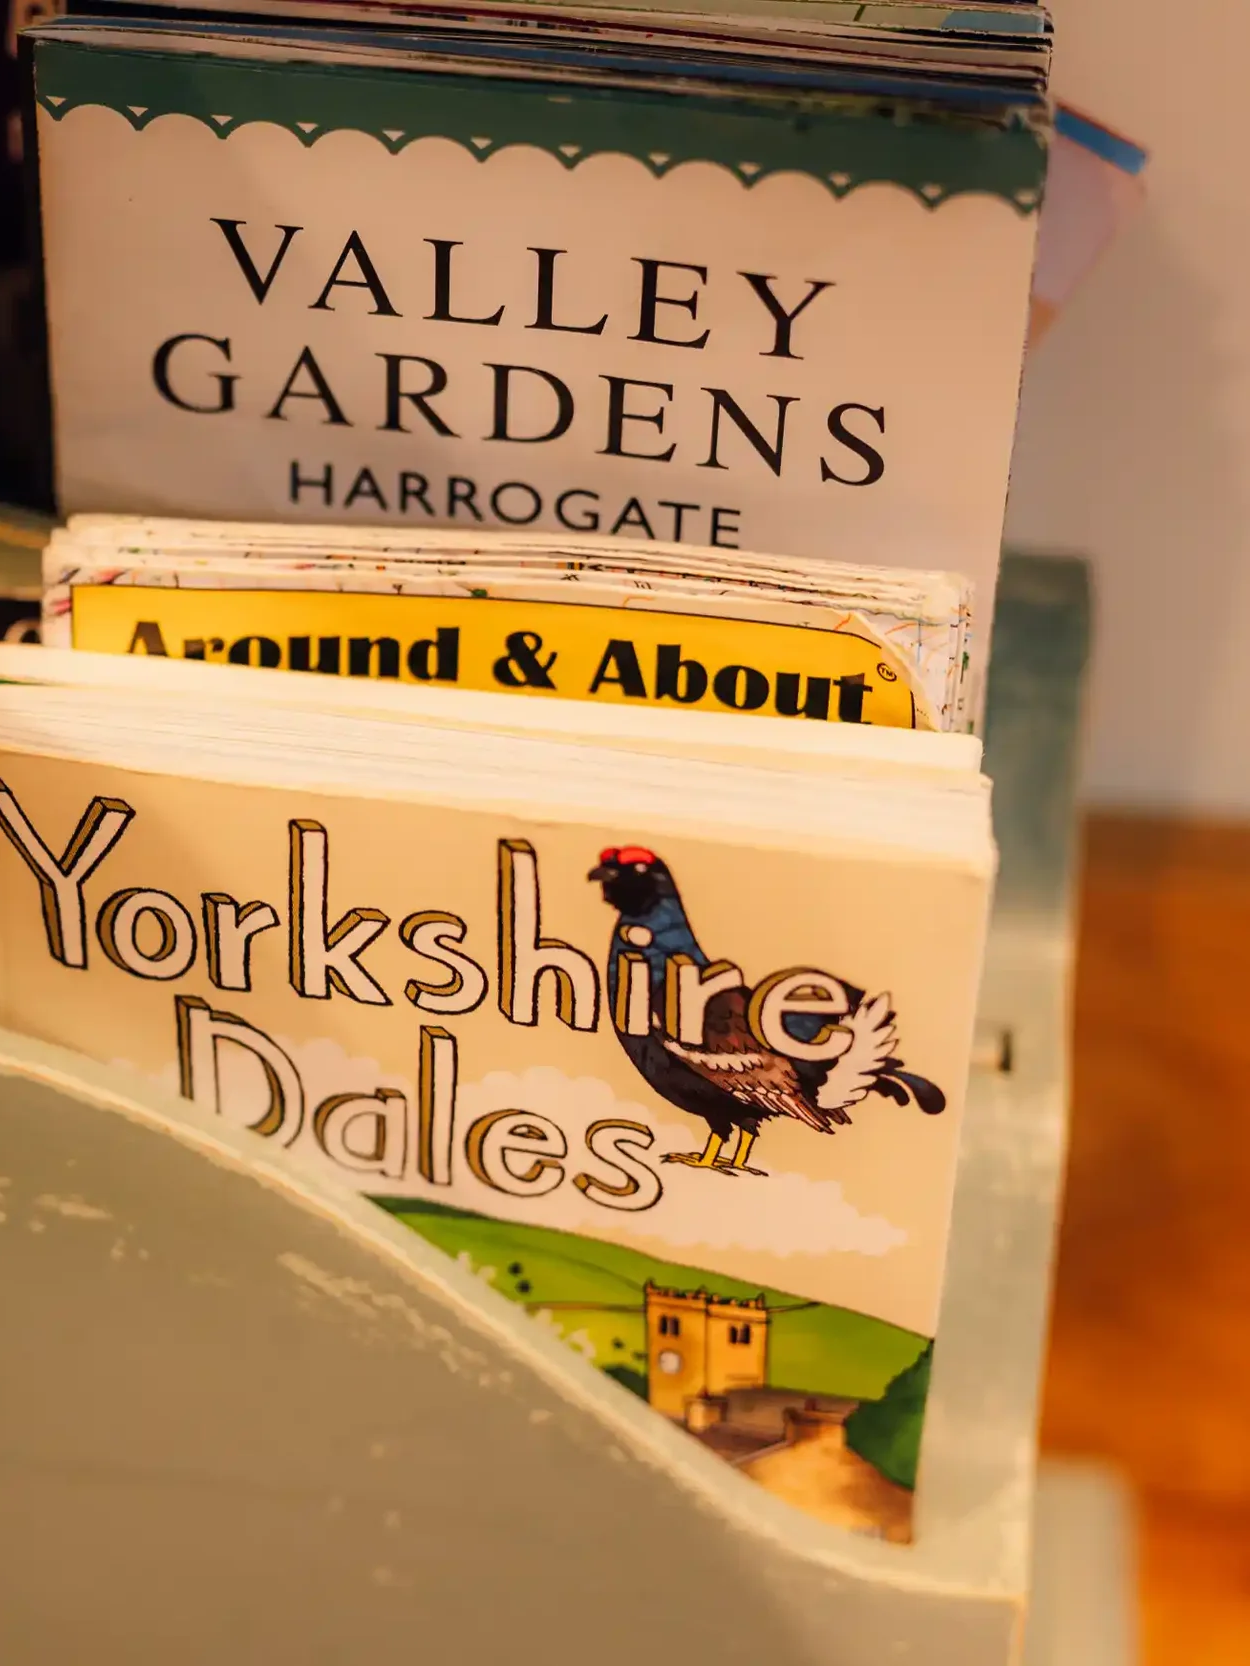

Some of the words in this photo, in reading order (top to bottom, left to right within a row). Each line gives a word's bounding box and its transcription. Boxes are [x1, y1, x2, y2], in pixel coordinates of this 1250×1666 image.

[209, 216, 837, 360] VALLEY
[151, 332, 888, 489] GARDENS
[290, 460, 742, 549] HARROGATE
[492, 631, 557, 690] &
[588, 639, 873, 725] About
[174, 994, 663, 1212] Dales
